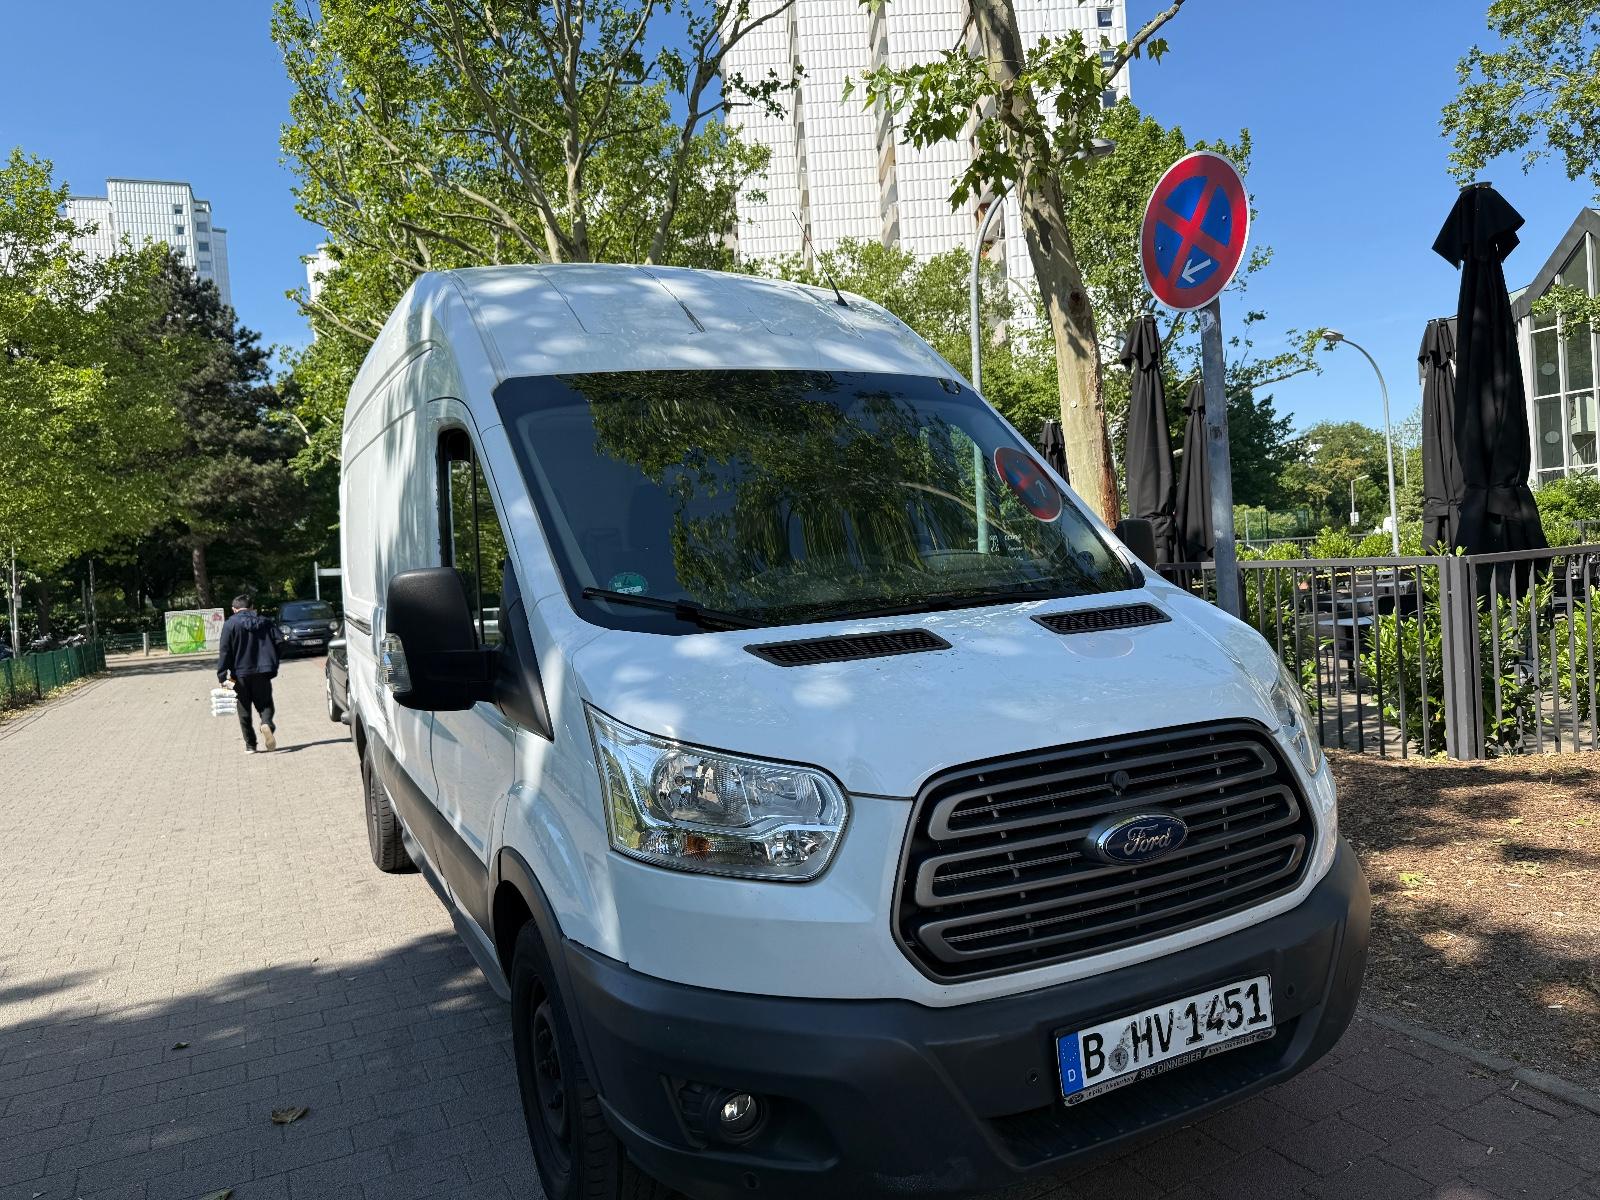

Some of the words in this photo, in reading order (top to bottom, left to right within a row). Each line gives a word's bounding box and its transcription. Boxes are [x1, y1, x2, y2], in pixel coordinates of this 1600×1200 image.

[1124, 824, 1171, 855] Ford
[1083, 1033, 1105, 1078] B
[1131, 1009, 1174, 1063] HV
[1184, 983, 1267, 1046] 1451
[1157, 1051, 1202, 1073] DINNEBIER
[1067, 1069, 1076, 1082] D
